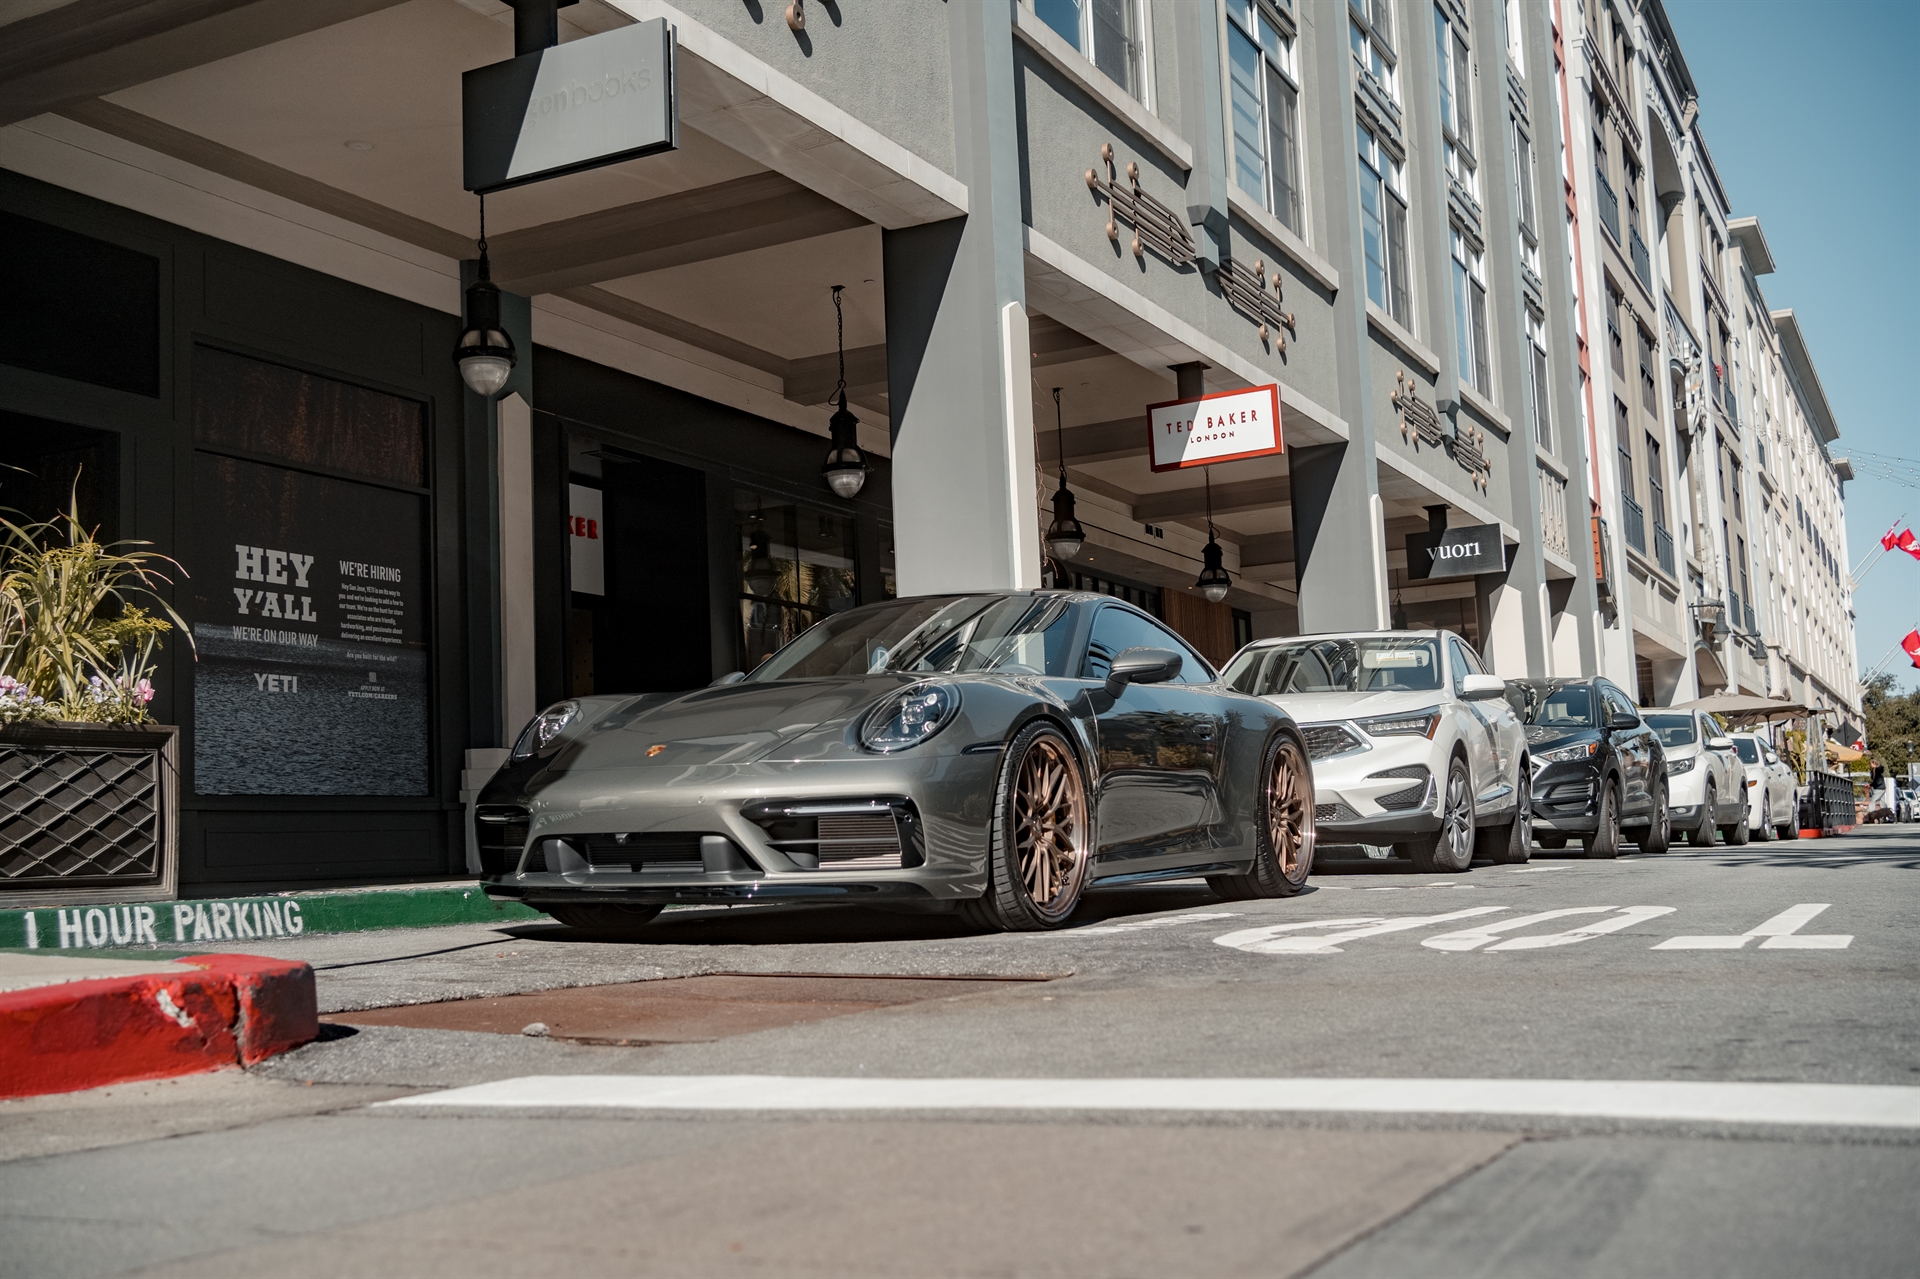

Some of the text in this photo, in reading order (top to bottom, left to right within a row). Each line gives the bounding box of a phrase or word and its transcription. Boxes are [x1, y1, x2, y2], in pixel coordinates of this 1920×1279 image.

[1166, 409, 1258, 434] TED BAKER
[1190, 430, 1235, 443] LONDON
[1425, 541, 1482, 560] vuori
[235, 544, 314, 588] HEY
[339, 560, 401, 583] WE'RE HIRING
[233, 587, 317, 623] Y'ALL
[233, 625, 319, 648] WE'RE ON OUR WAY
[253, 672, 298, 694] YETI
[24, 900, 304, 949] 1 HOUR PARKING
